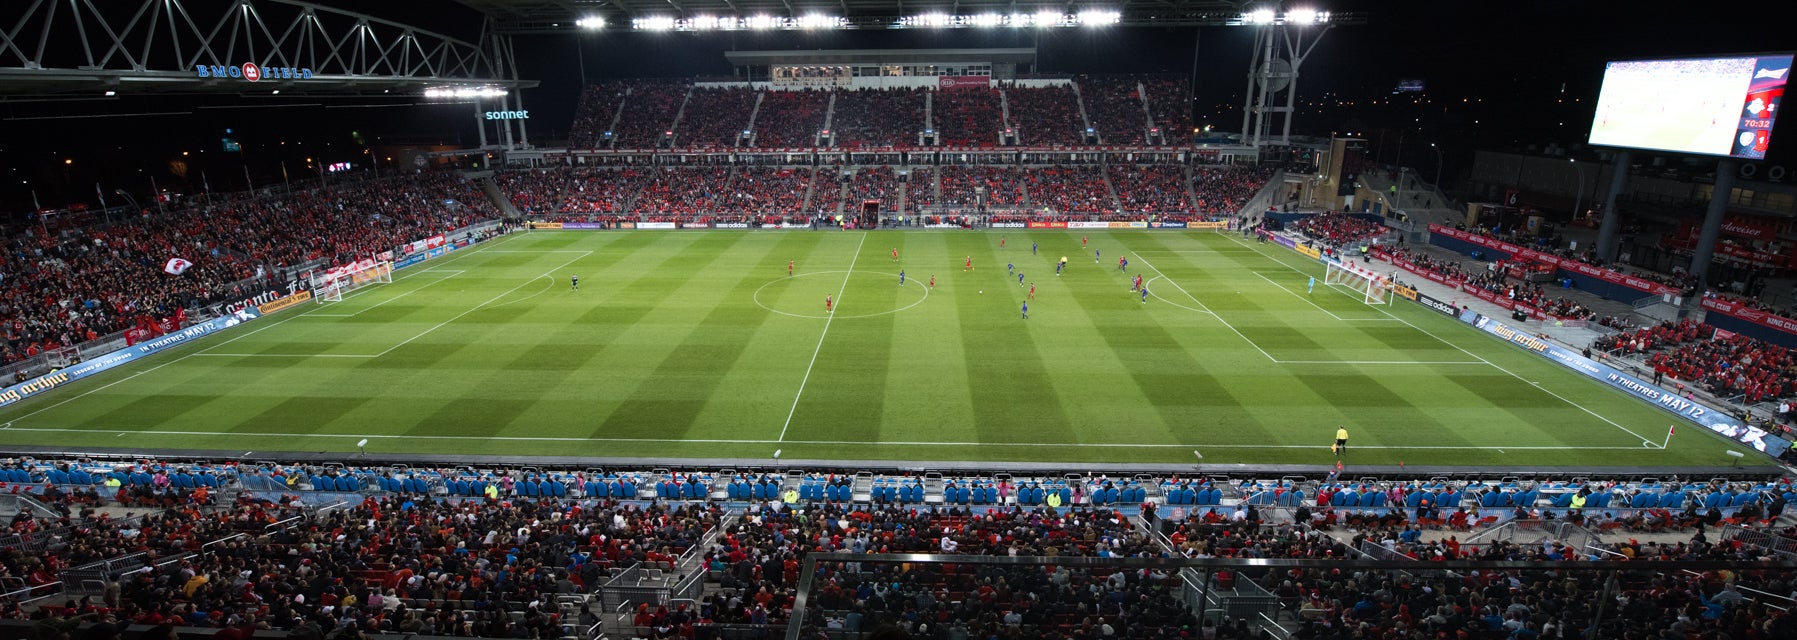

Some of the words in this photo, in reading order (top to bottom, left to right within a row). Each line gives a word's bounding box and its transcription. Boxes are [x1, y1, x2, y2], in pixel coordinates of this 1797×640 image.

[196, 65, 241, 78] BMO
[262, 66, 313, 79] FIELD
[1767, 103, 1775, 111] 2
[486, 110, 530, 120] sonnet
[1744, 120, 1770, 128] 70:32
[1759, 136, 1765, 144] 1
[1510, 193, 1517, 205] 6
[328, 279, 350, 291] addas
[260, 297, 293, 313] Continental
[1433, 300, 1455, 316] adidas
[1702, 299, 1716, 308] KING
[1715, 303, 1732, 312] CLUB
[1766, 316, 1783, 327] KING
[1783, 321, 1797, 332] CLU
[139, 345, 150, 353] IN
[150, 333, 186, 351] THEATRES
[184, 324, 205, 339] MAY
[203, 322, 217, 332] 12
[0, 389, 22, 404] ng
[1607, 372, 1618, 381] IN
[1617, 376, 1660, 399] THEATRES
[1659, 393, 1691, 412] MAY
[1688, 406, 1705, 419] 12
